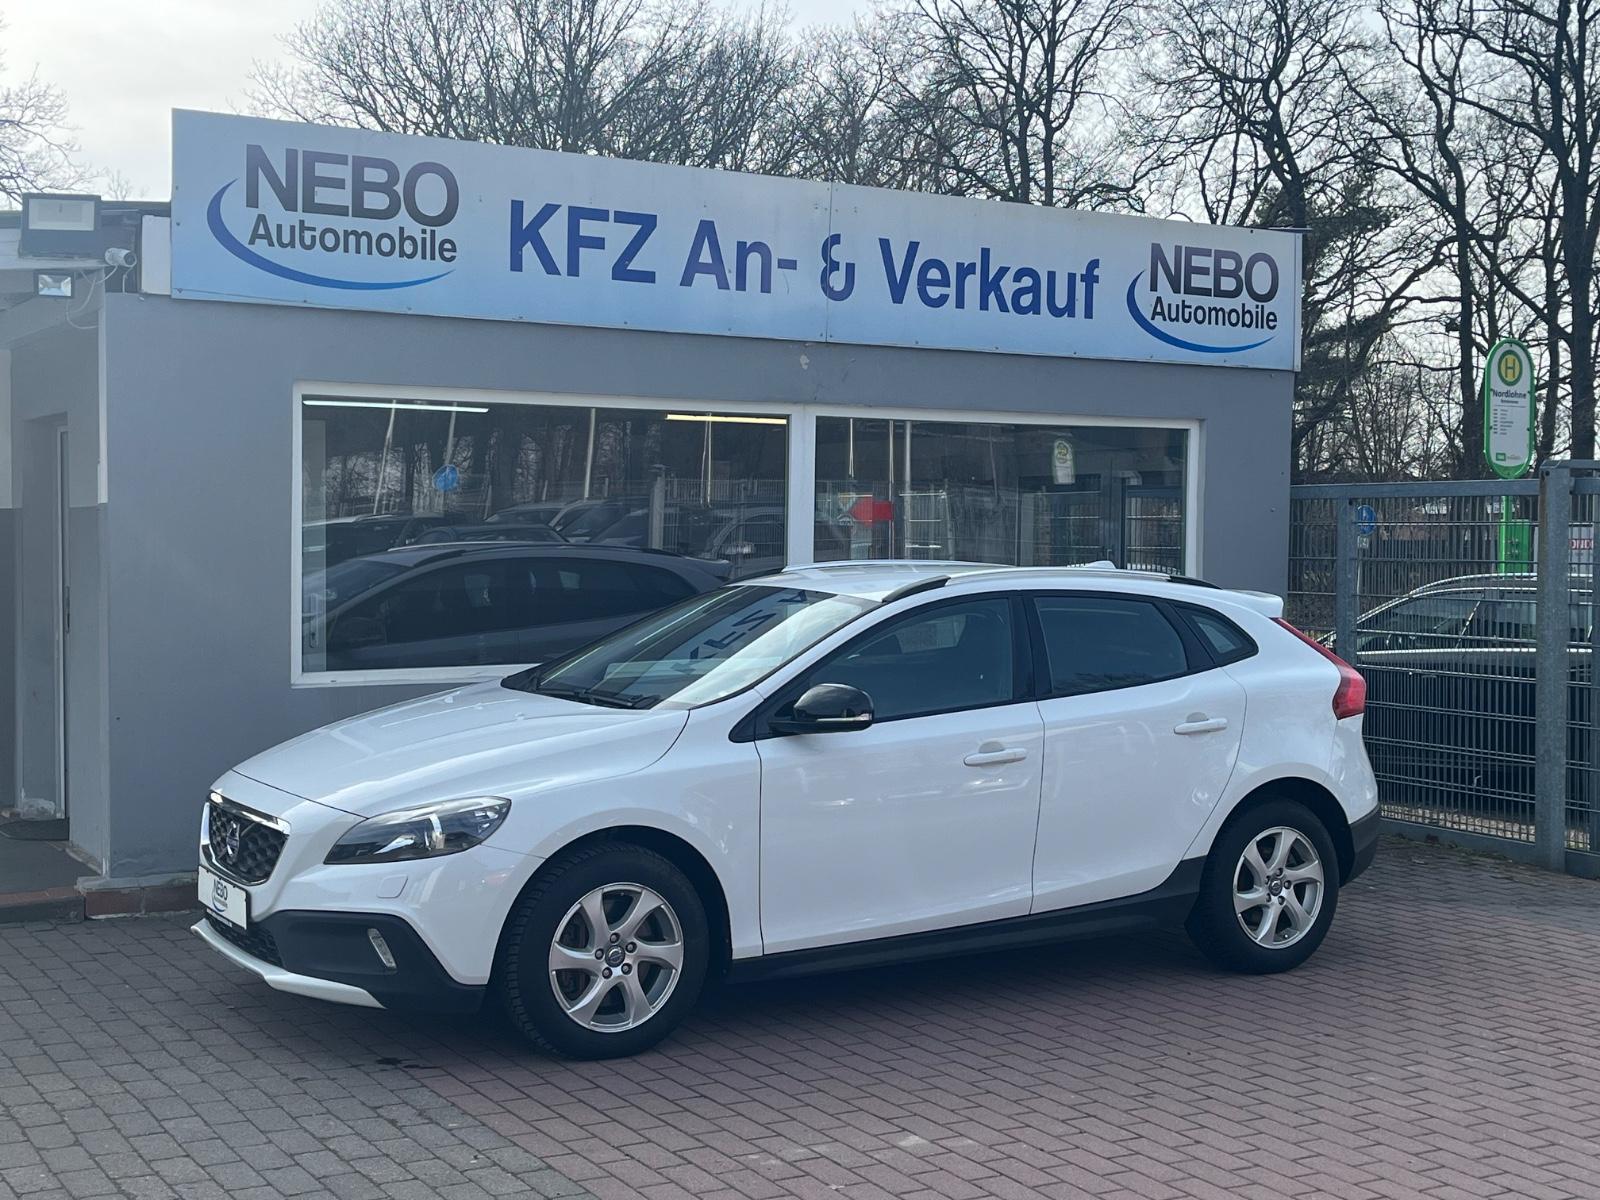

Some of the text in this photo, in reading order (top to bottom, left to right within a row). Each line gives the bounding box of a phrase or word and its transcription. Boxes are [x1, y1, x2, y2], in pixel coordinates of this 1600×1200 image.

[246, 143, 459, 228] NEBO
[248, 213, 457, 263] Automobile
[510, 199, 1100, 319] KFZ An- & Verkauf
[1149, 242, 1280, 303] NEBO
[1150, 296, 1278, 330] Automobile
[1505, 357, 1516, 379] H
[1493, 389, 1527, 399] Nordlohne
